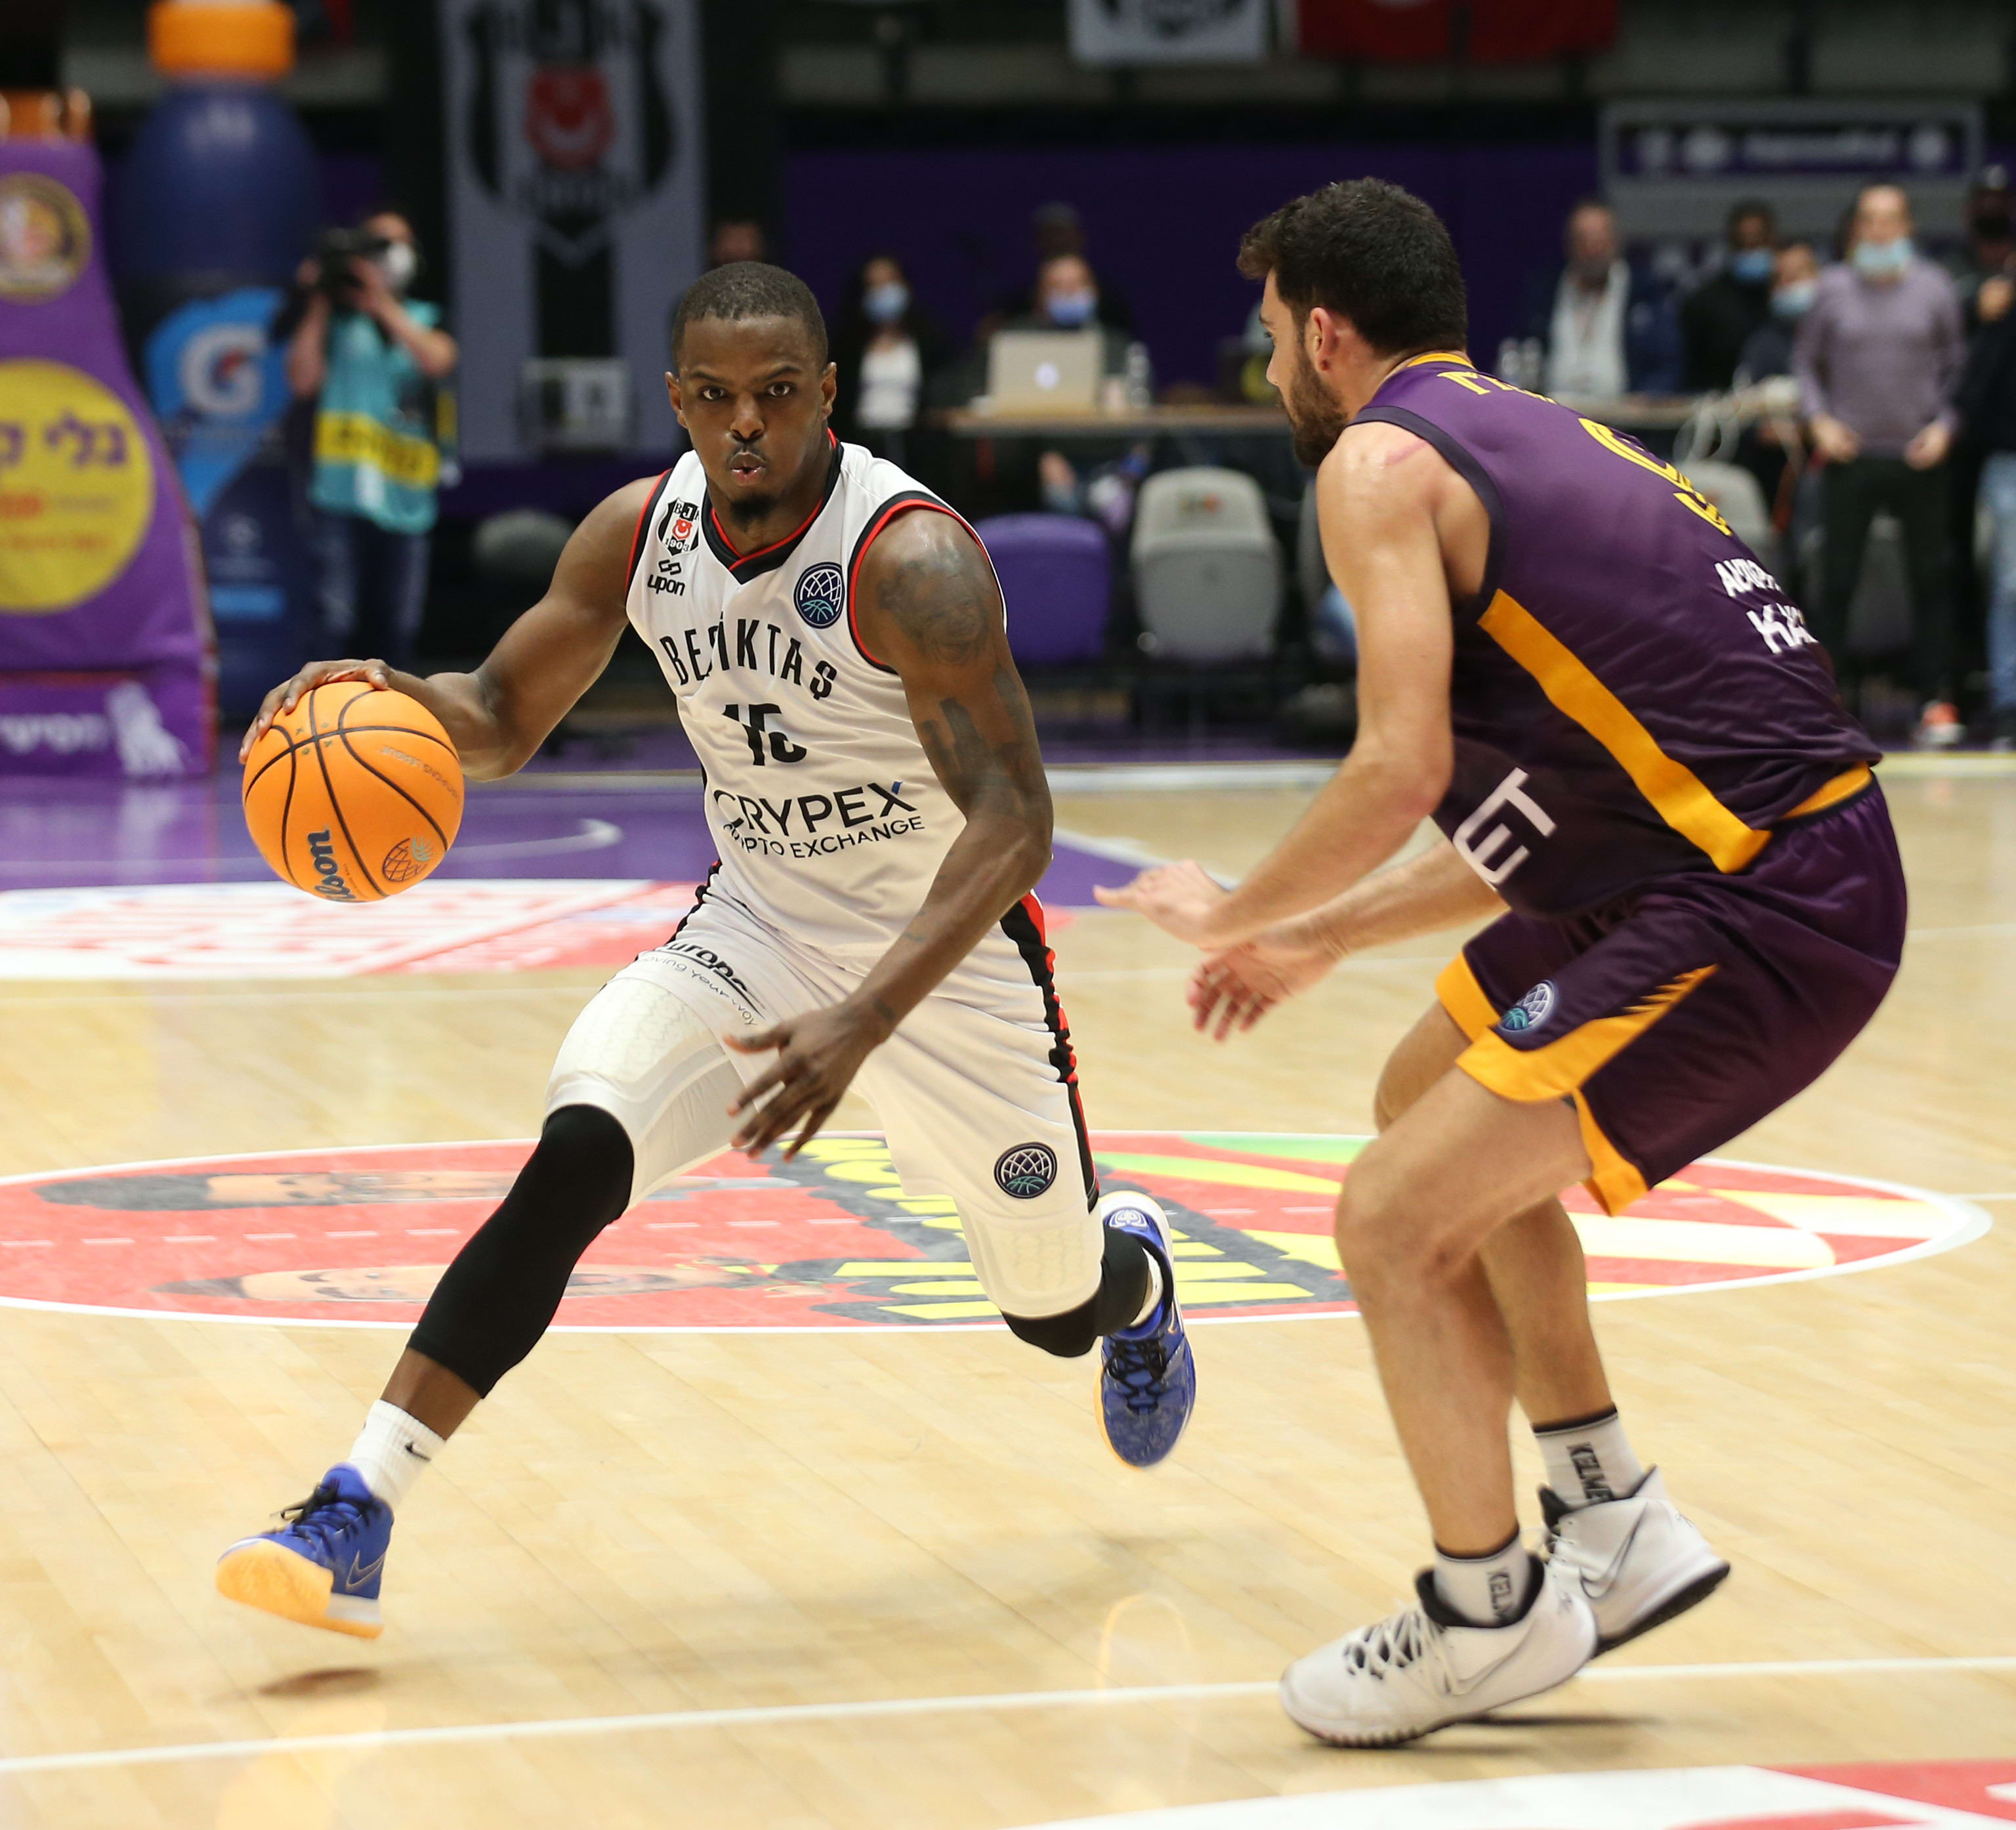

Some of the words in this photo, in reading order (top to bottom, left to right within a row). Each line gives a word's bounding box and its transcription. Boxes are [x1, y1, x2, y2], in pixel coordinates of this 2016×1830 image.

[665, 538, 690, 552] 1903
[647, 574, 686, 597] upon
[713, 781, 917, 837] CRYPEX
[789, 816, 925, 859] EXCHANGE
[642, 956, 688, 972] oving
